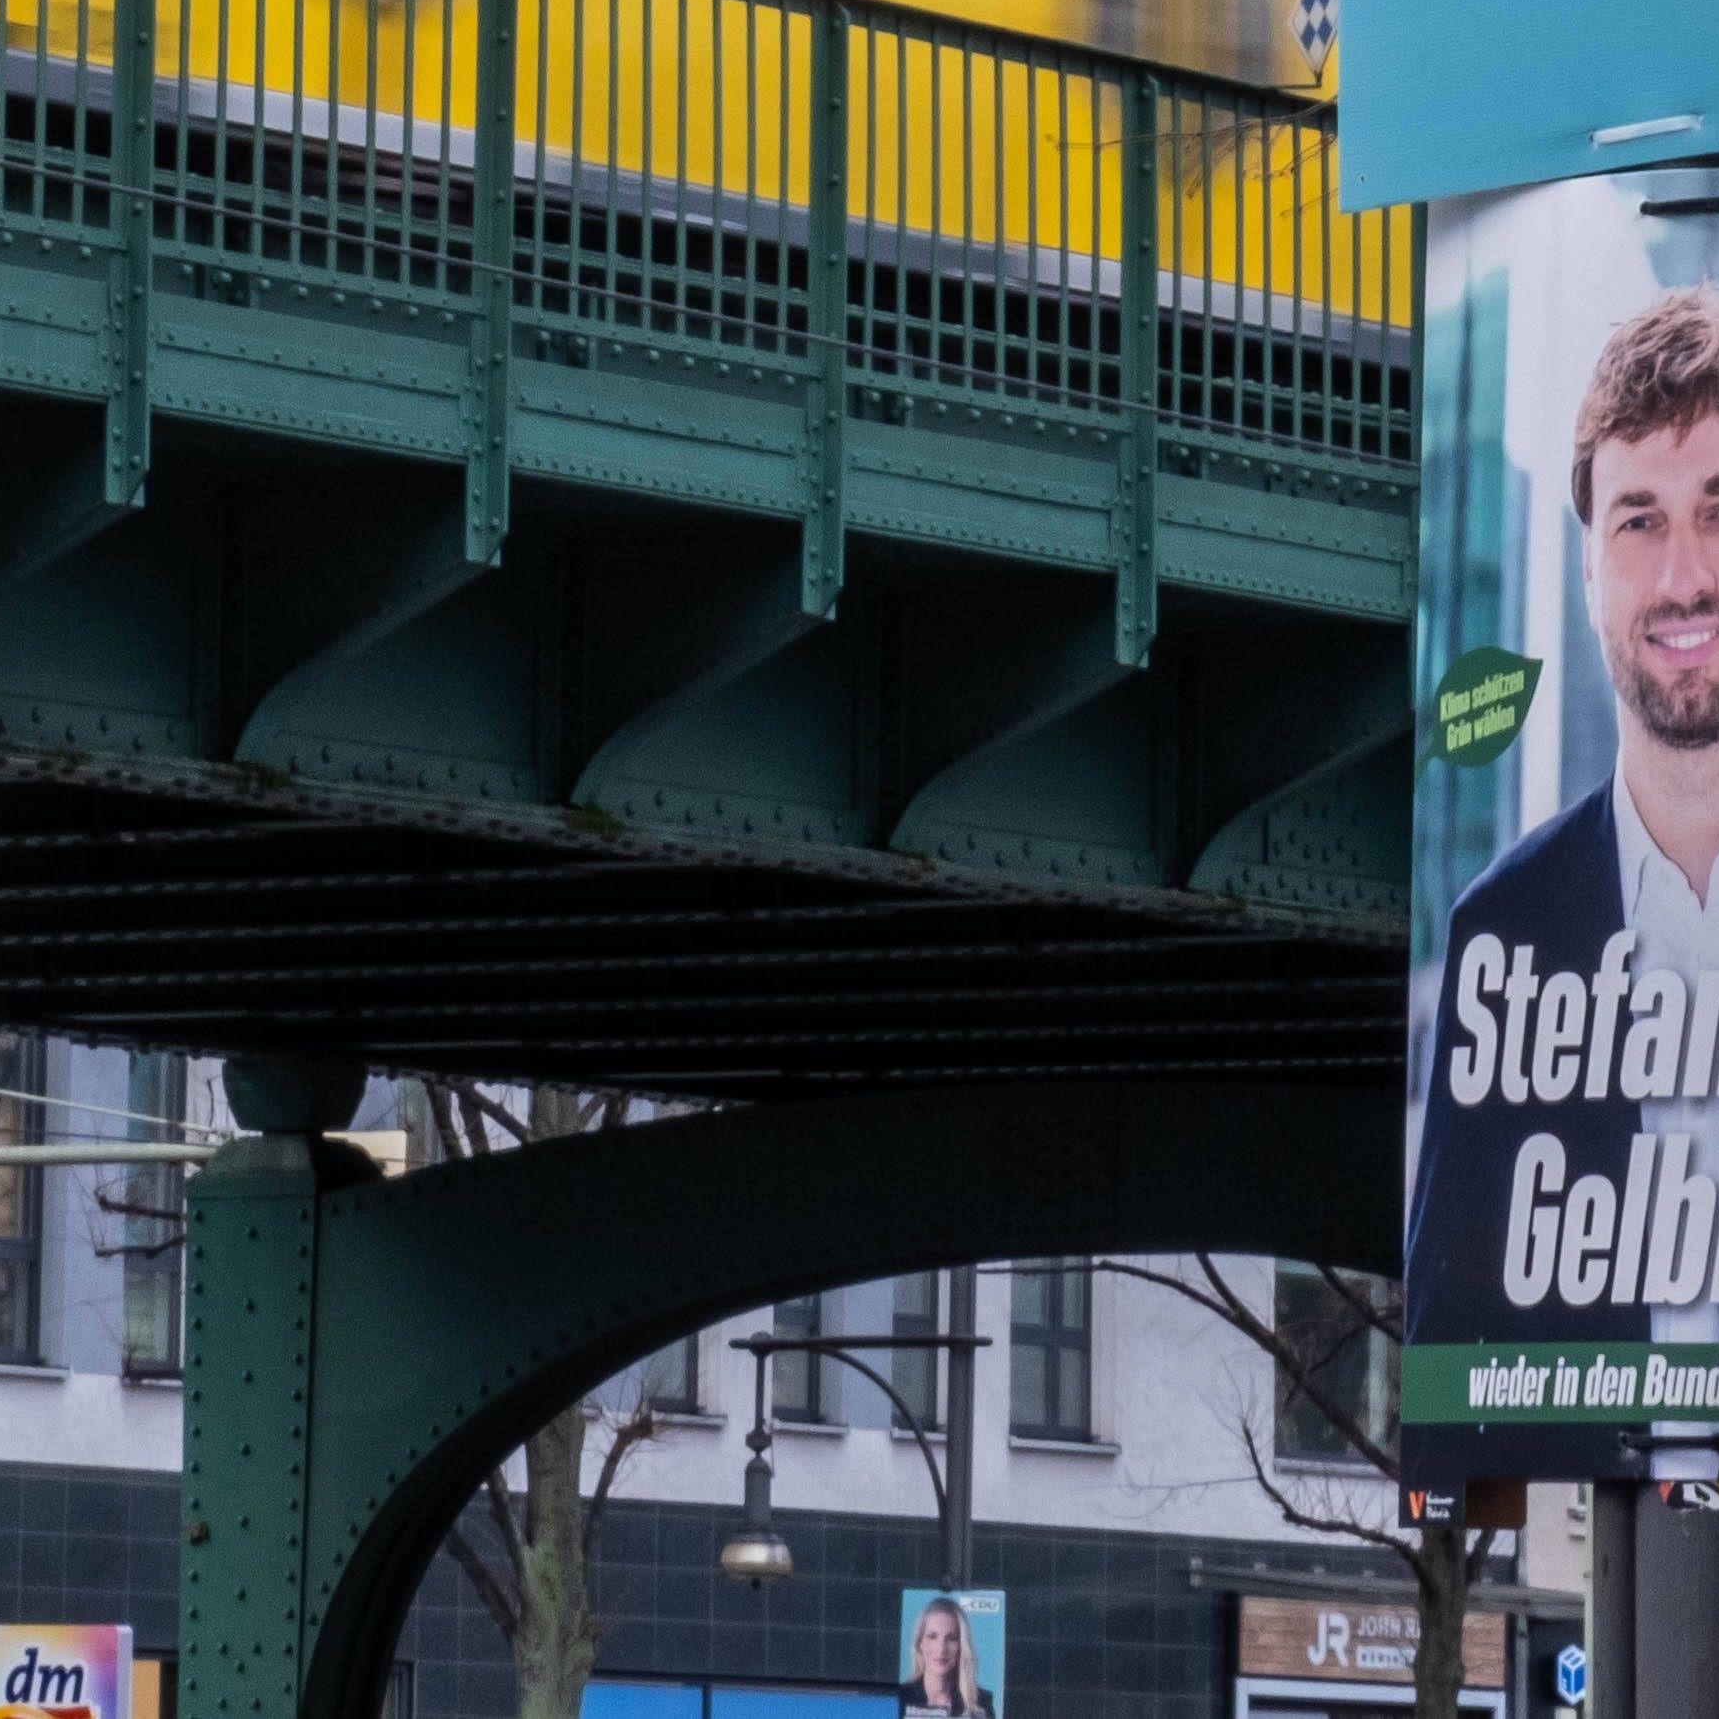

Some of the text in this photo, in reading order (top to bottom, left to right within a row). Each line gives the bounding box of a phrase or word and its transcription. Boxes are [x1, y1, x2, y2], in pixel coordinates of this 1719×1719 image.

[1469, 1354, 1551, 1408] wieder
[1552, 1356, 1581, 1408] in
[1583, 1353, 1638, 1408] den
[5, 1647, 85, 1703] dm
